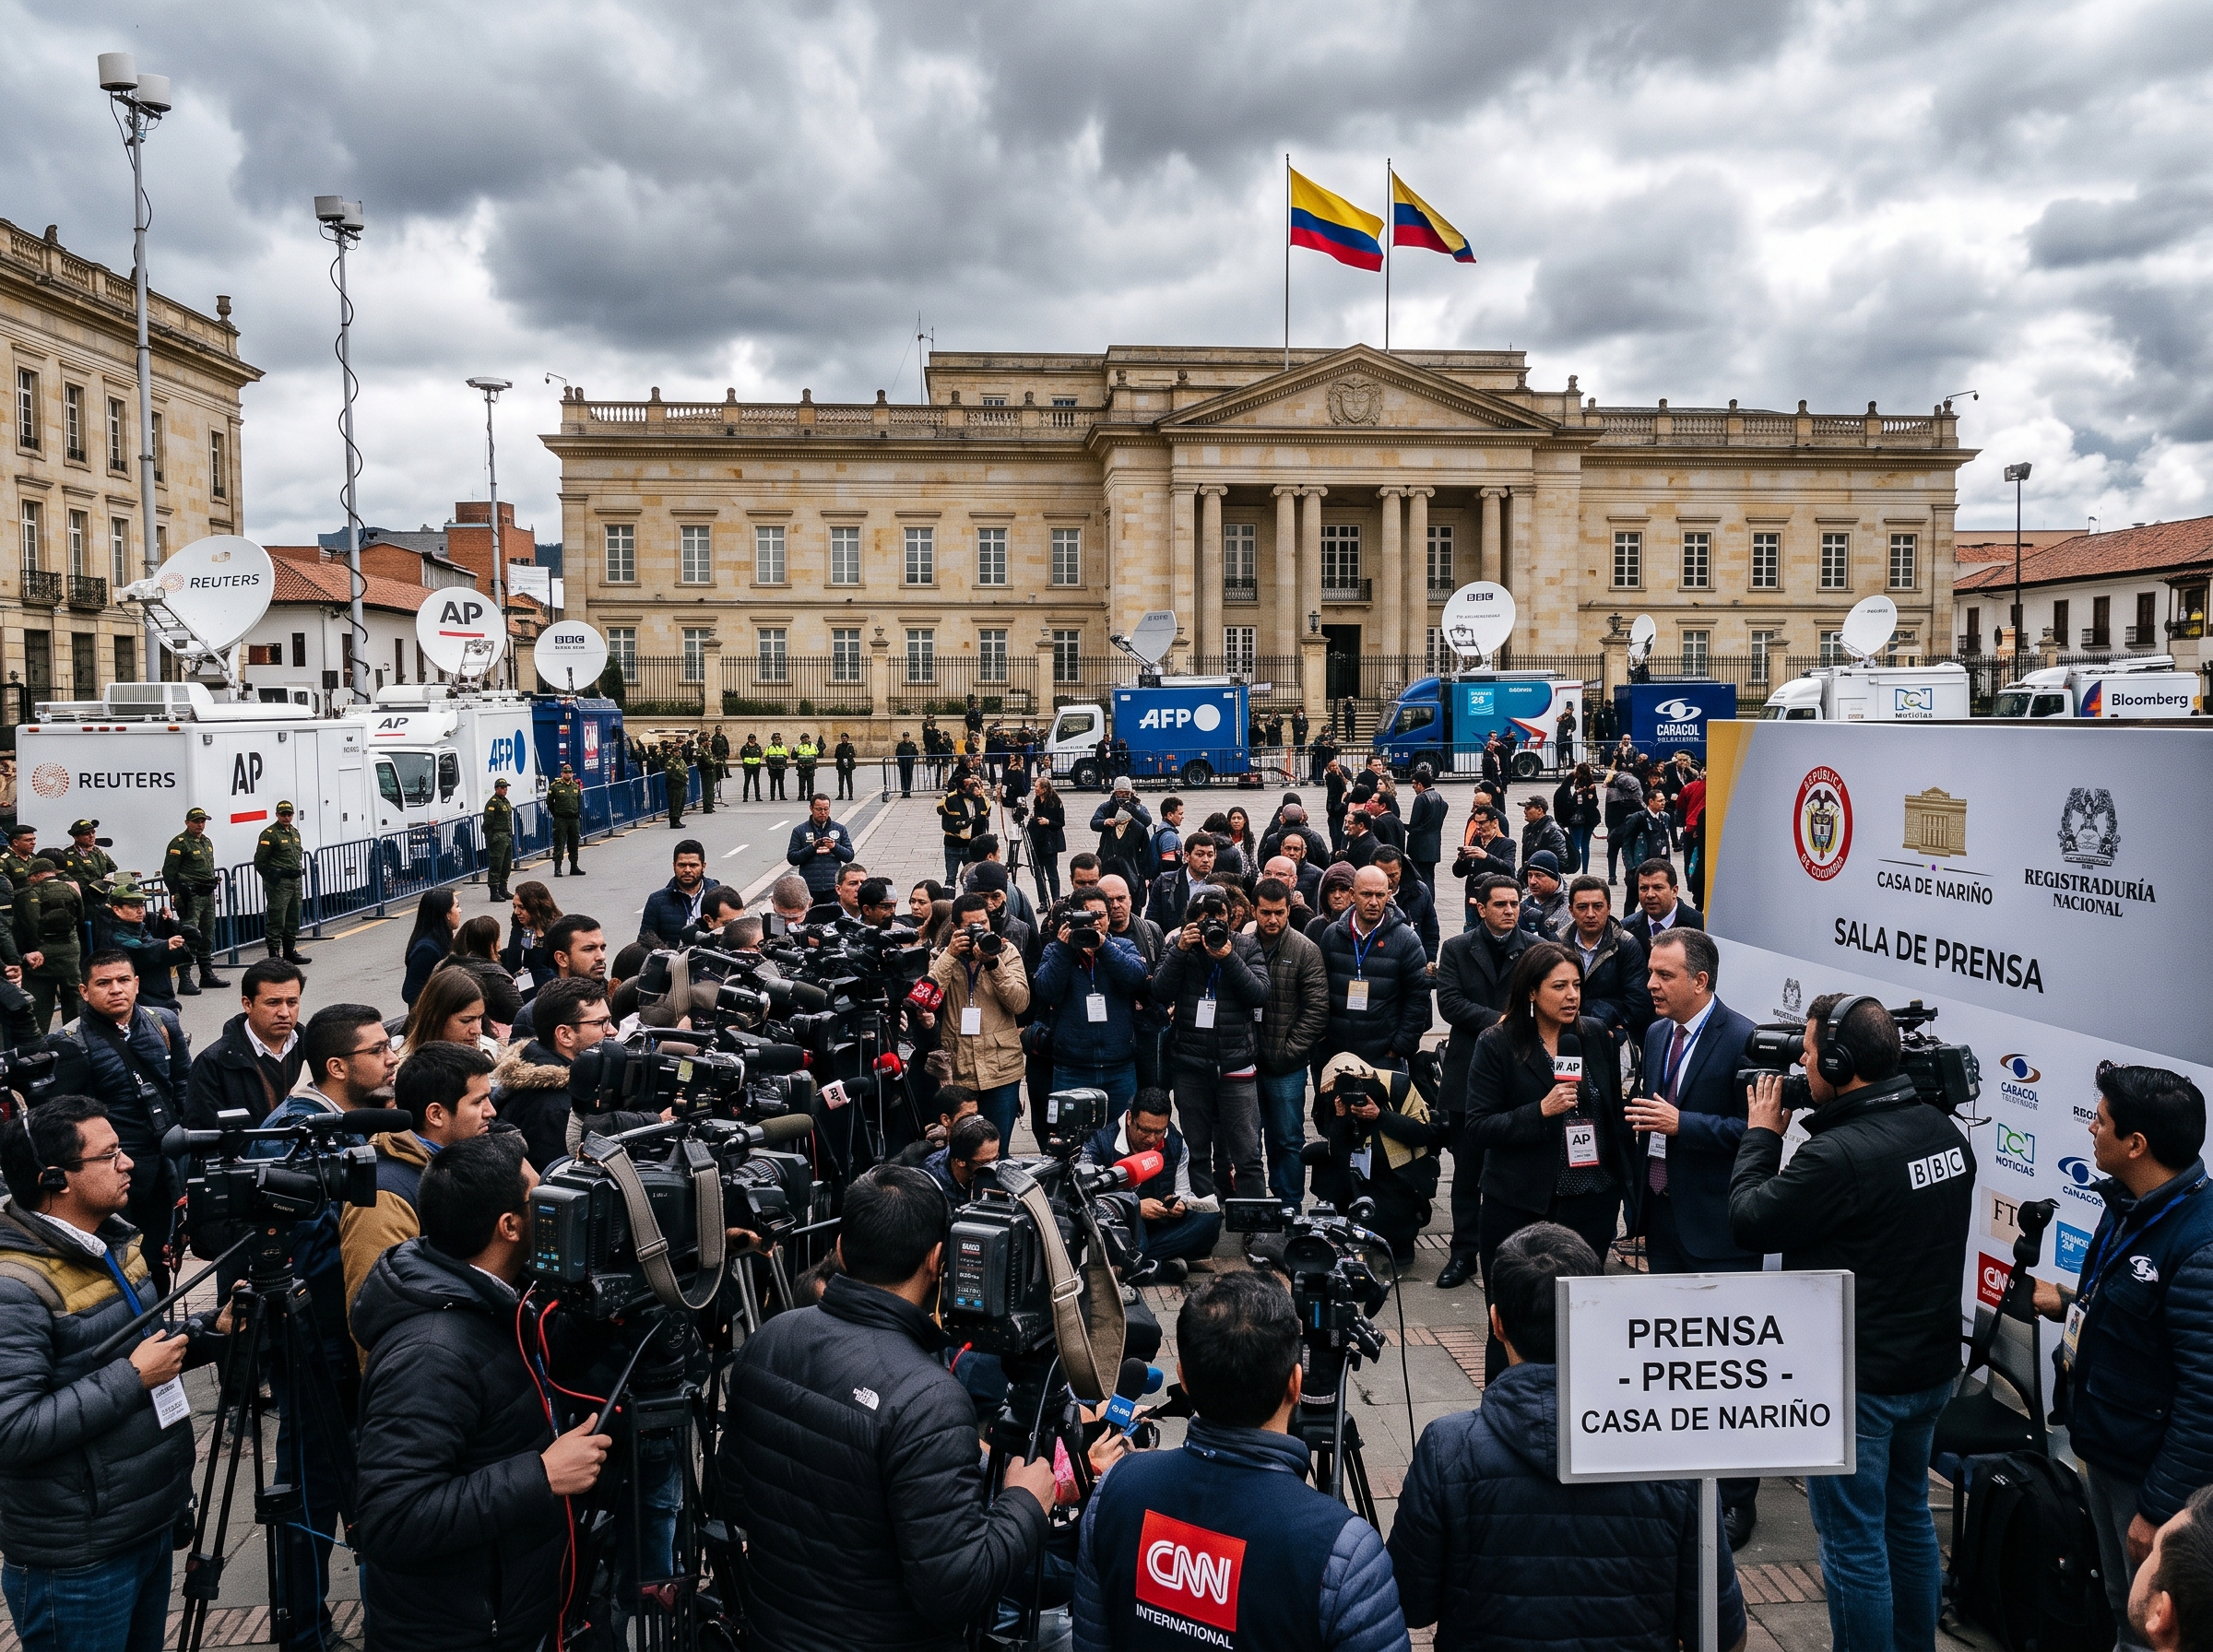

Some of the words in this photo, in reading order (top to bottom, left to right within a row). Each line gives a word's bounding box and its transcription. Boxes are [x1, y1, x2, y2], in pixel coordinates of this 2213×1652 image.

[190, 573, 259, 589] REUTERS
[439, 600, 483, 625] AP
[2112, 692, 2188, 708] Bloomberg
[378, 717, 408, 729] AP
[1139, 708, 1191, 729] AFP
[1656, 724, 1700, 737] CARACOL
[488, 738, 514, 773] AFP
[78, 772, 176, 789] REUTERS
[231, 751, 263, 796] AP
[1876, 871, 1911, 892] CASA
[1914, 875, 1933, 896] DE
[1936, 879, 1994, 905] NARIÑO
[2024, 867, 2157, 903] REGISTRADURÍA
[2053, 892, 2124, 918] NACIONAL
[1834, 917, 1889, 957] SALA
[1896, 929, 1927, 965] DE
[1935, 938, 2044, 994] PRENSA
[2001, 1081, 2039, 1103] CARACOL
[1572, 1133, 1592, 1146] AP
[1911, 1149, 1965, 1187] BBC
[1995, 1154, 2035, 1177] NOTICIAS
[1994, 1198, 2018, 1227] FT
[1628, 1315, 1784, 1349] PRENSA
[1642, 1359, 1768, 1391] PRESS
[1581, 1409, 1663, 1434] CASA
[1671, 1407, 1709, 1432] DE
[1719, 1398, 1831, 1430] NARIÑO
[1146, 1540, 1232, 1605] CNN
[1136, 1603, 1234, 1650] INTERNATIONAL
